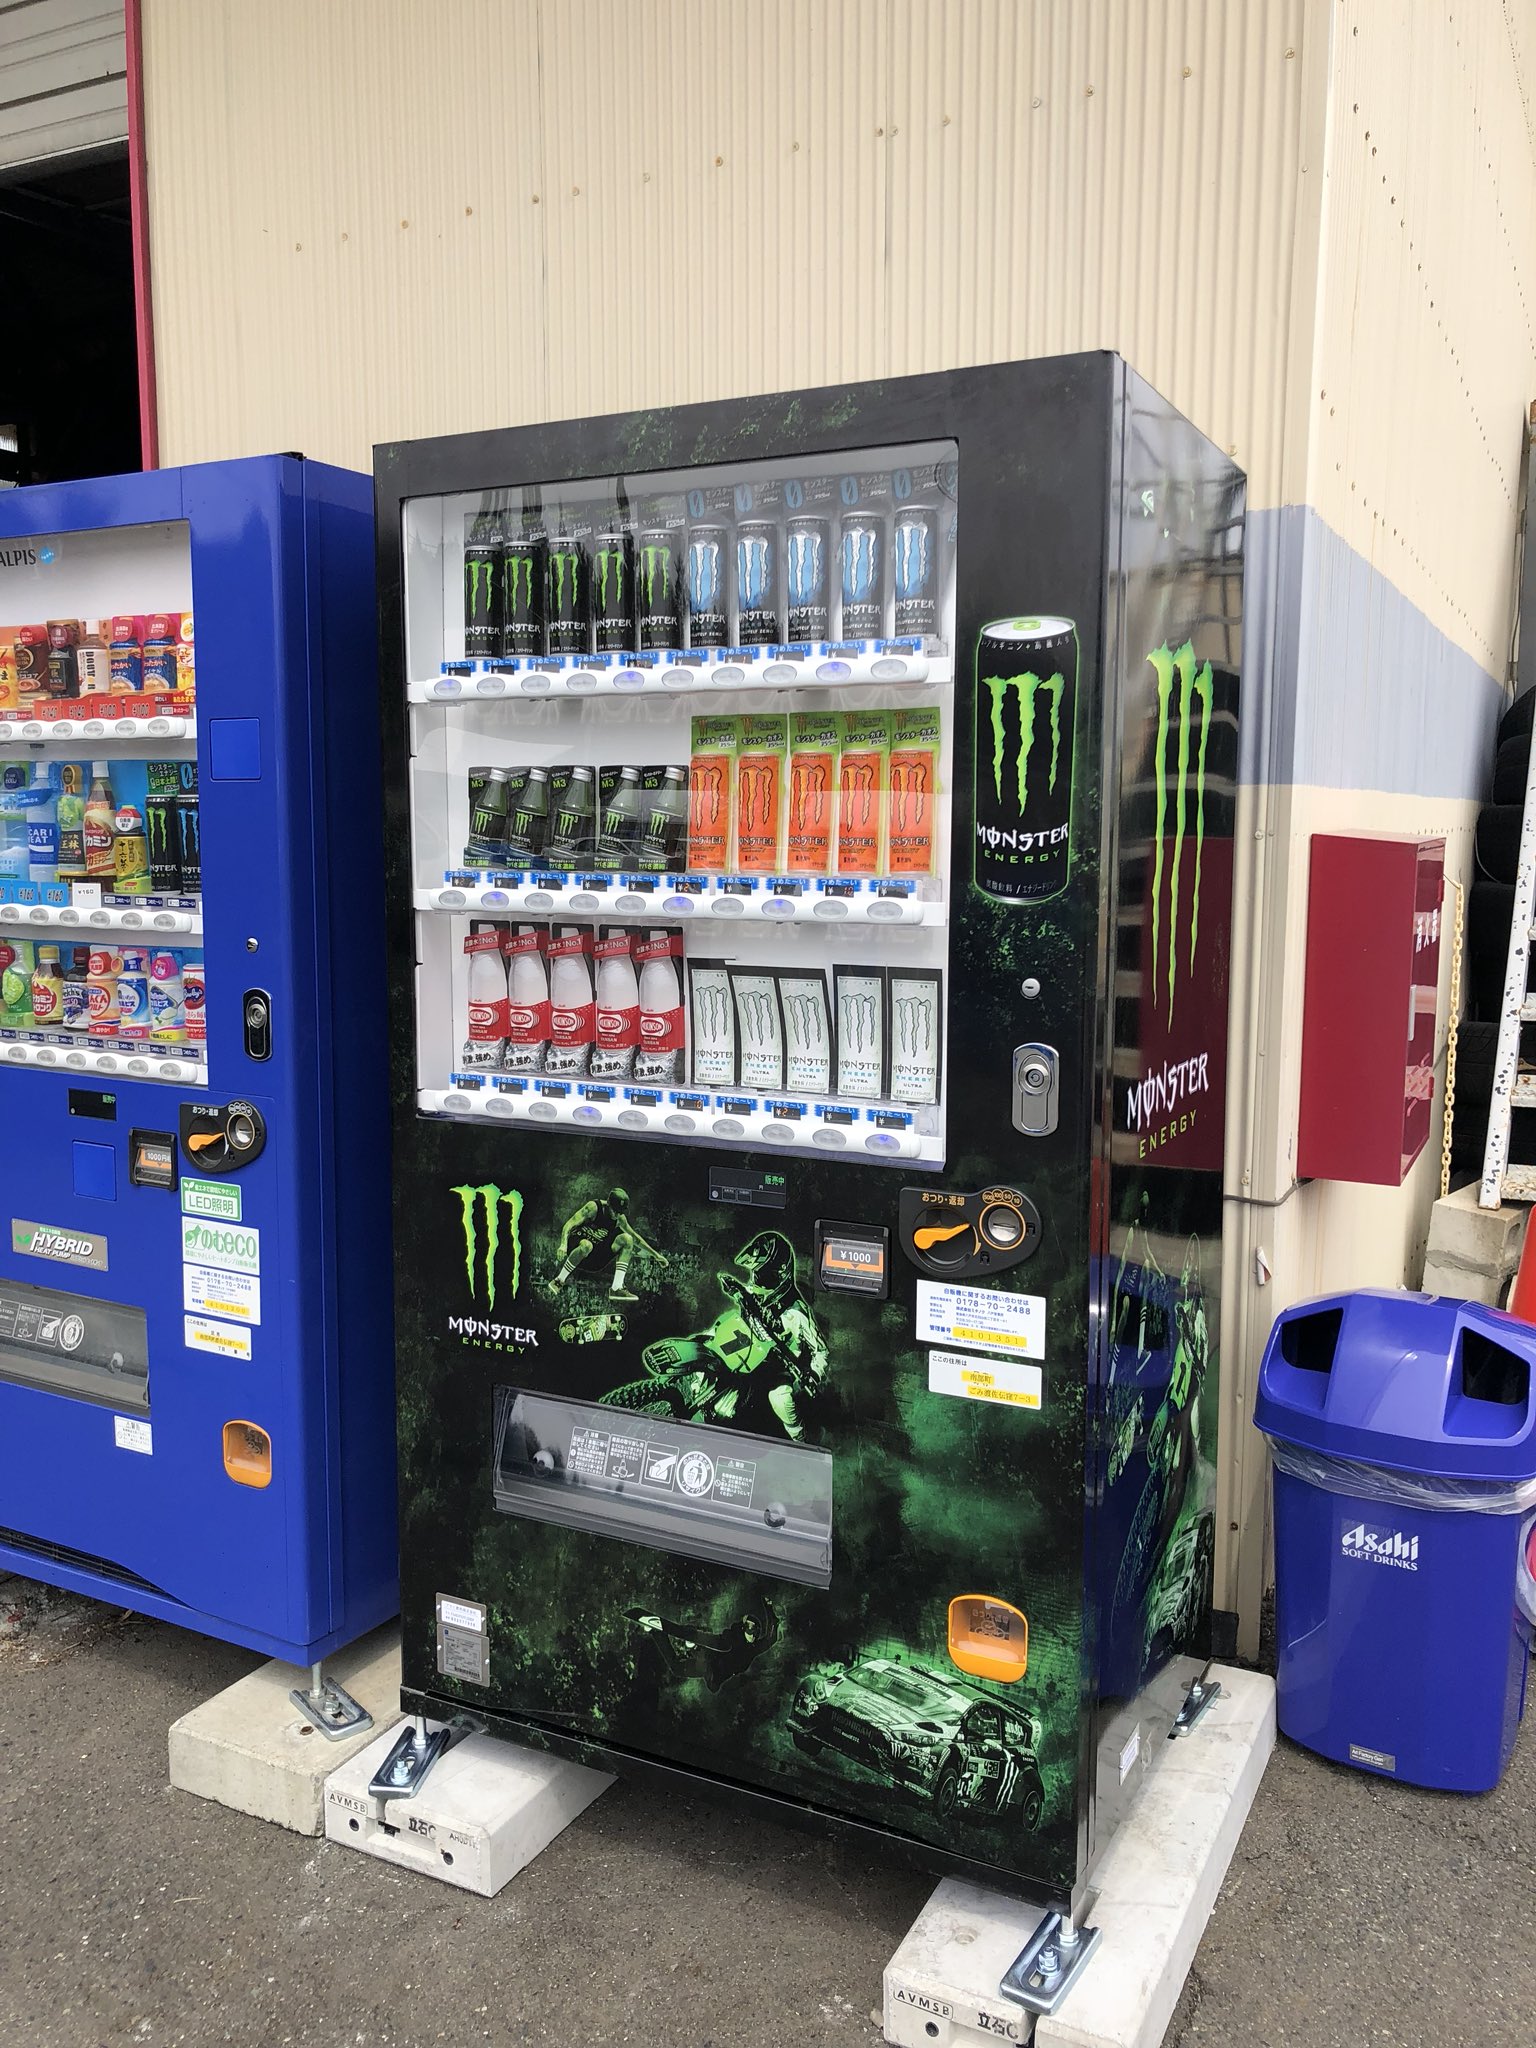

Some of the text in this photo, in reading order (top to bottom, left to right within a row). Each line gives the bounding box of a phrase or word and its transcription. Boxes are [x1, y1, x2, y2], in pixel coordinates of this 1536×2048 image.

[0, 549, 36, 567] ALPIS
[842, 604, 881, 615] ONSTER
[896, 599, 935, 611] ONSTER
[690, 612, 725, 624] ONSTER
[739, 610, 776, 621] ONSTER
[789, 607, 827, 619] ONSTER
[550, 620, 587, 631] ONSTER
[596, 618, 632, 630] ONSTER
[641, 615, 678, 627] ONSTER
[465, 625, 500, 636] ONSTER
[505, 622, 541, 635] ONSTER
[471, 779, 484, 788] M3
[511, 779, 524, 789] M3
[553, 779, 567, 789] M3
[601, 778, 615, 789] M3
[644, 778, 658, 789] M3
[689, 836, 725, 846] ONSTER
[739, 836, 775, 846] ONSTER
[789, 835, 828, 846] ONSTER
[839, 836, 875, 847] ONSTER
[890, 836, 929, 847] ONSTER
[977, 822, 1069, 851] MONSTER
[984, 850, 1060, 864] ENERGY
[150, 864, 178, 872] NSTER
[1127, 1052, 1209, 1132] MONSTER
[1139, 1109, 1198, 1160] ENERGY
[764, 1174, 785, 1186] 販売中
[189, 1195, 234, 1215] LED照明
[922, 1192, 965, 1206] おつり・返却
[31, 1232, 93, 1255] HYBRID
[202, 1225, 257, 1259] のむeco
[34, 1246, 71, 1260] HEAT PUMP
[840, 1250, 871, 1264] ¥1000
[944, 1288, 1029, 1306] 自販機に関するお問い合わせは
[956, 1297, 1031, 1315] 0178-70-2488
[448, 1315, 540, 1347] MONSTER
[930, 1324, 951, 1333] 管理番号
[960, 1330, 1018, 1344] 4101351
[462, 1337, 526, 1355] ENERGY
[932, 1355, 967, 1366] ここの住所は
[970, 1373, 991, 1384] 南部町
[1341, 1523, 1419, 1563] Asahi
[1342, 1546, 1418, 1571] SOFT DRINKS
[329, 1792, 367, 1814] AVMSB
[408, 1817, 437, 1840] 立石C
[896, 1989, 950, 2016] AVMSB
[977, 2011, 1019, 2040] 立石C
